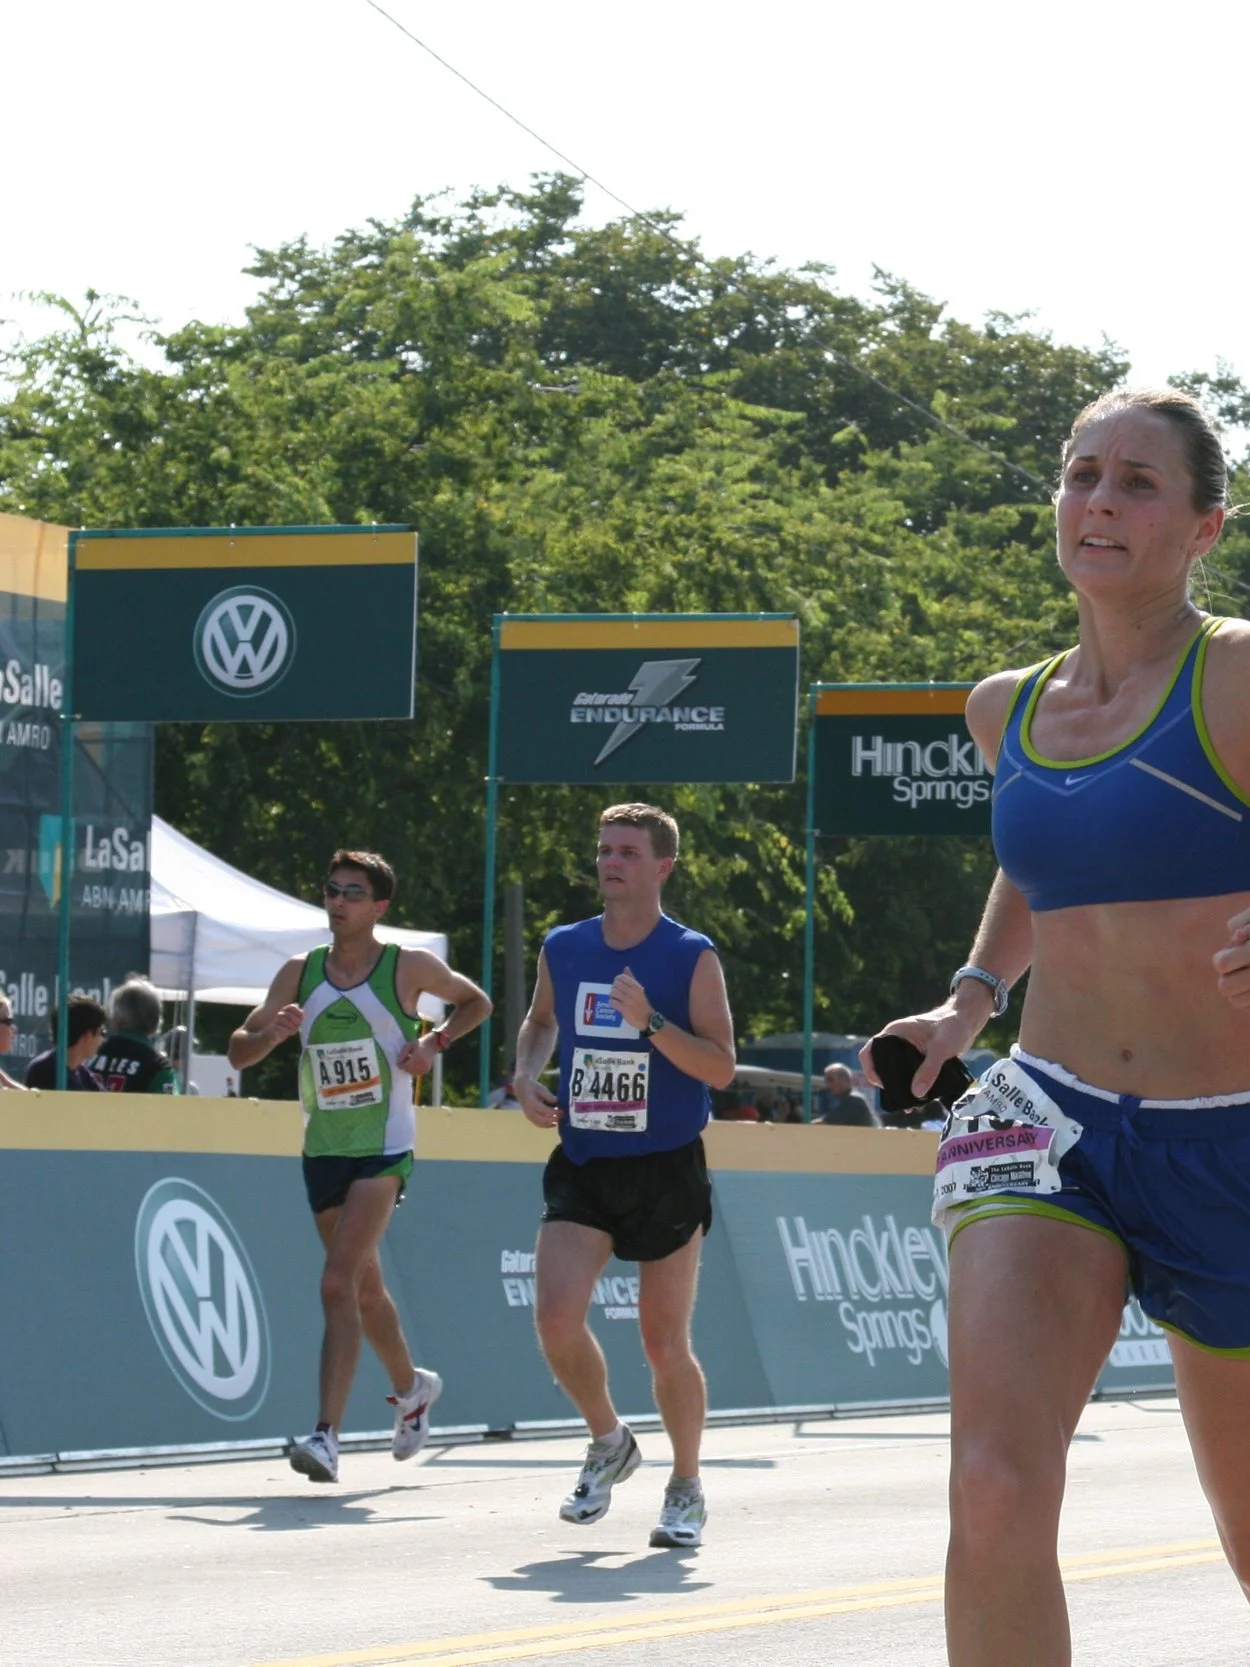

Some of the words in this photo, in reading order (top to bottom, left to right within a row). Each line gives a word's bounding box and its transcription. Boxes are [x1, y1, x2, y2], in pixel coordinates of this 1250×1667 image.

[202, 595, 288, 688] VW
[570, 707, 725, 723] ENDURANCE
[675, 723, 724, 731] FORMULA
[6, 722, 51, 750] AMRO
[852, 734, 986, 777] Hinckl
[892, 776, 989, 809] Springs
[85, 825, 151, 872] LaSal
[82, 885, 113, 909] ABN
[114, 888, 151, 915] AMR
[320, 1061, 331, 1085] A
[333, 1056, 371, 1085] 915
[572, 1068, 584, 1097] B
[589, 1071, 645, 1102] 4466
[984, 1068, 1024, 1108] LSalle
[940, 1182, 957, 1195] 2007
[501, 1250, 537, 1273] Gator
[148, 1199, 260, 1401] VW
[502, 1276, 639, 1307] ENNCE
[839, 1302, 933, 1367] Springs
